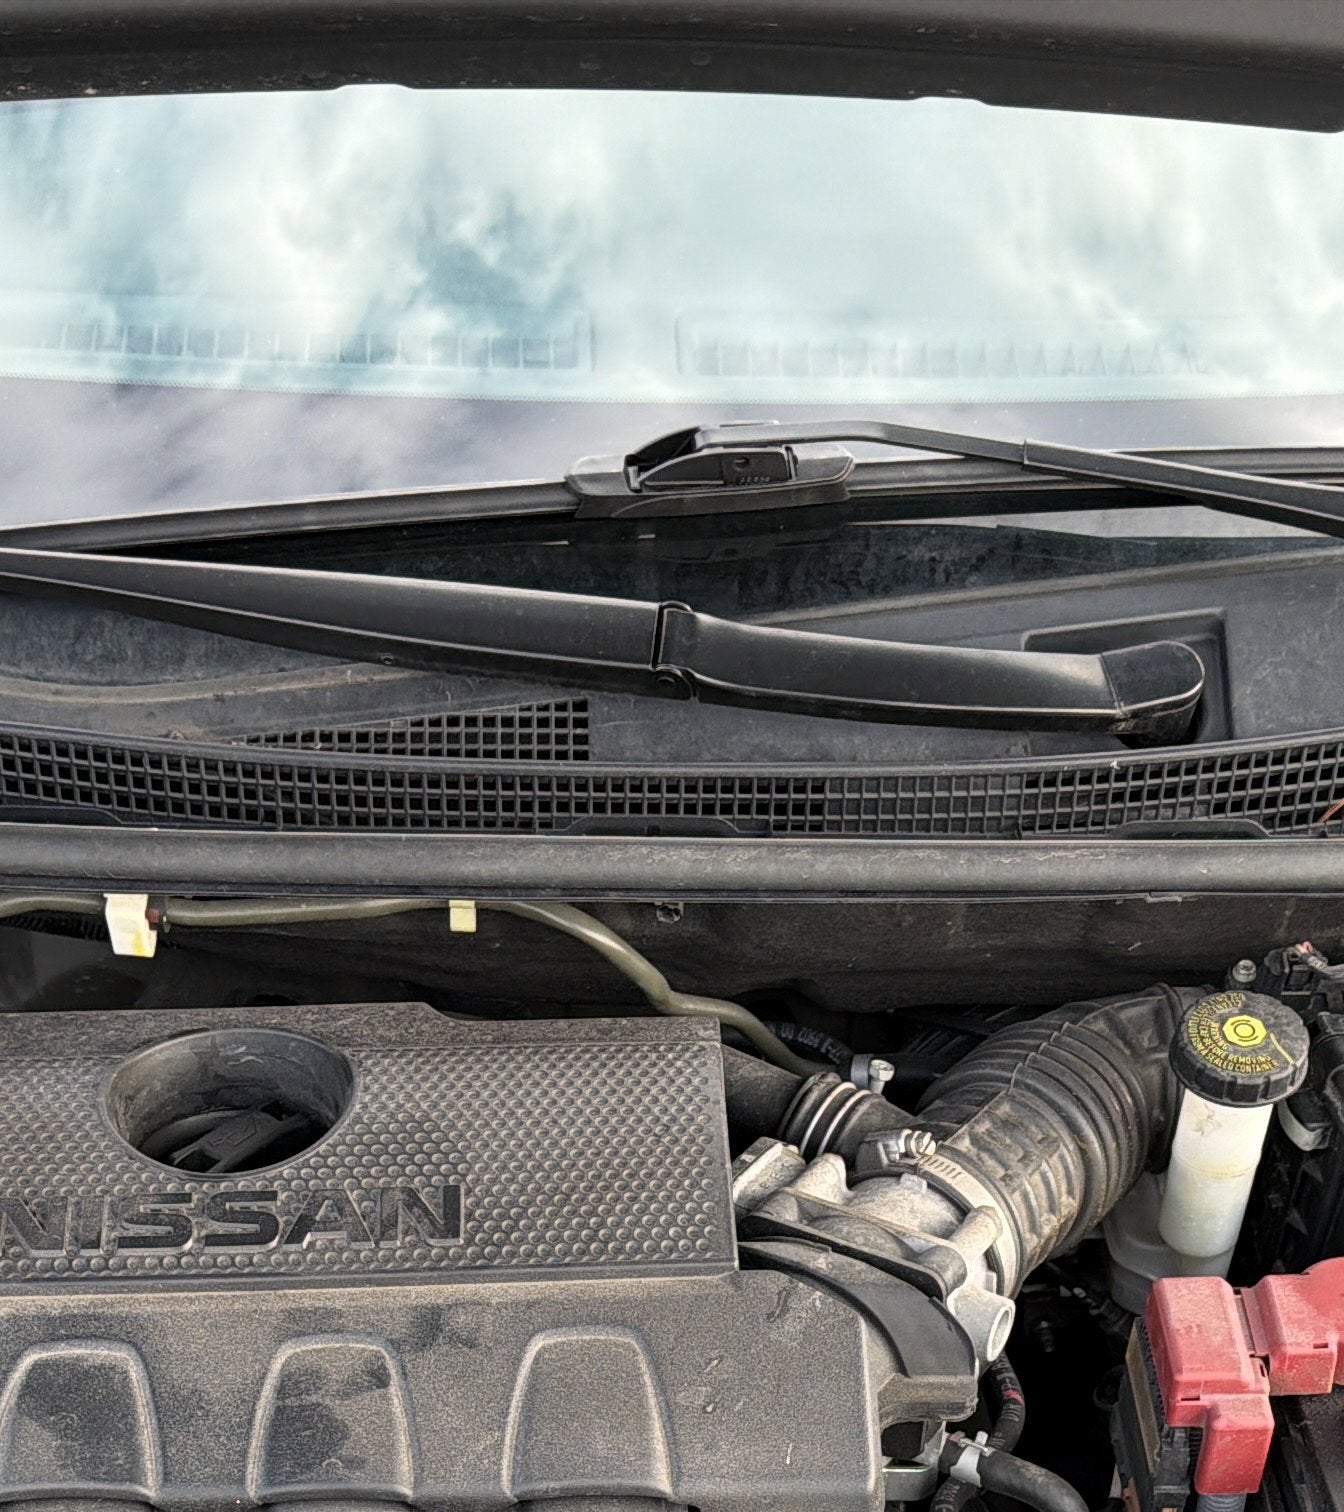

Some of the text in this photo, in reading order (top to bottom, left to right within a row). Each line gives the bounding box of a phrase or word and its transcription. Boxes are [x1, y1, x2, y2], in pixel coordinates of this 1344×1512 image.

[1205, 1052, 1234, 1070] SEALED
[1235, 1060, 1280, 1073] CONTAINER
[1228, 1054, 1271, 1063] REMOVING
